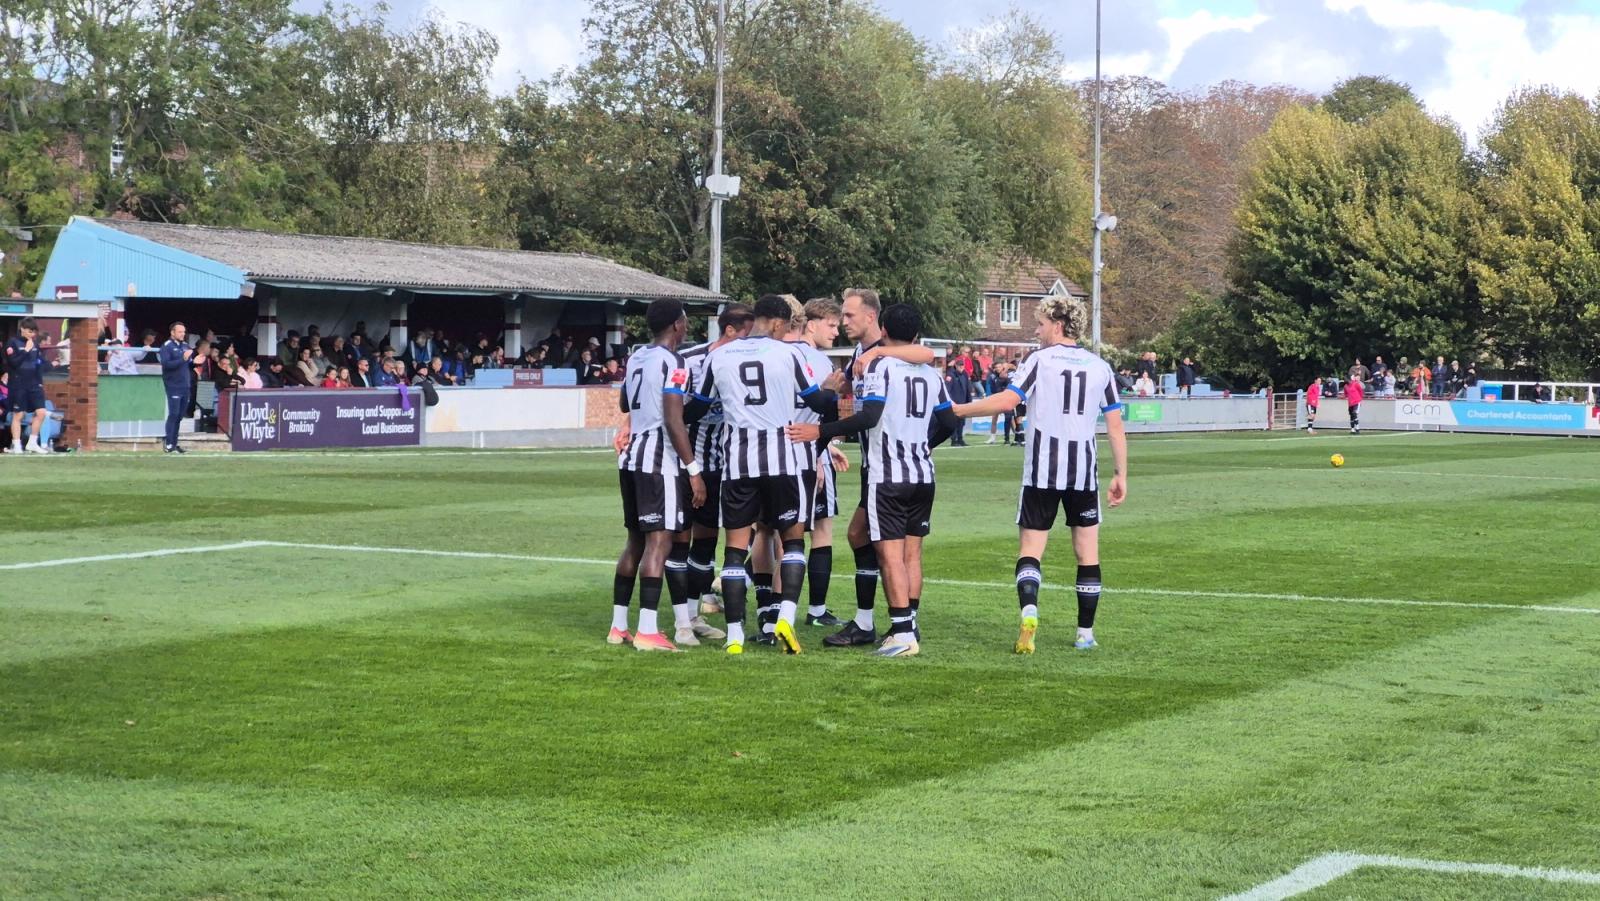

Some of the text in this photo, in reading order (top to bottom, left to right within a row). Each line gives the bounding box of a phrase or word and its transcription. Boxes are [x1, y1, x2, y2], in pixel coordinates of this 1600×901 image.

[631, 367, 644, 410] 2
[739, 360, 768, 406] 9
[903, 375, 928, 419] 10
[1060, 369, 1087, 415] 11
[282, 408, 321, 422] Community
[336, 405, 365, 421] Insuring
[365, 404, 379, 417] and
[1402, 403, 1441, 416] acm
[1467, 409, 1573, 422] Chartered Accountants
[240, 422, 275, 443] Whyte
[288, 421, 314, 435] Broking
[362, 421, 415, 435] Local Businesses
